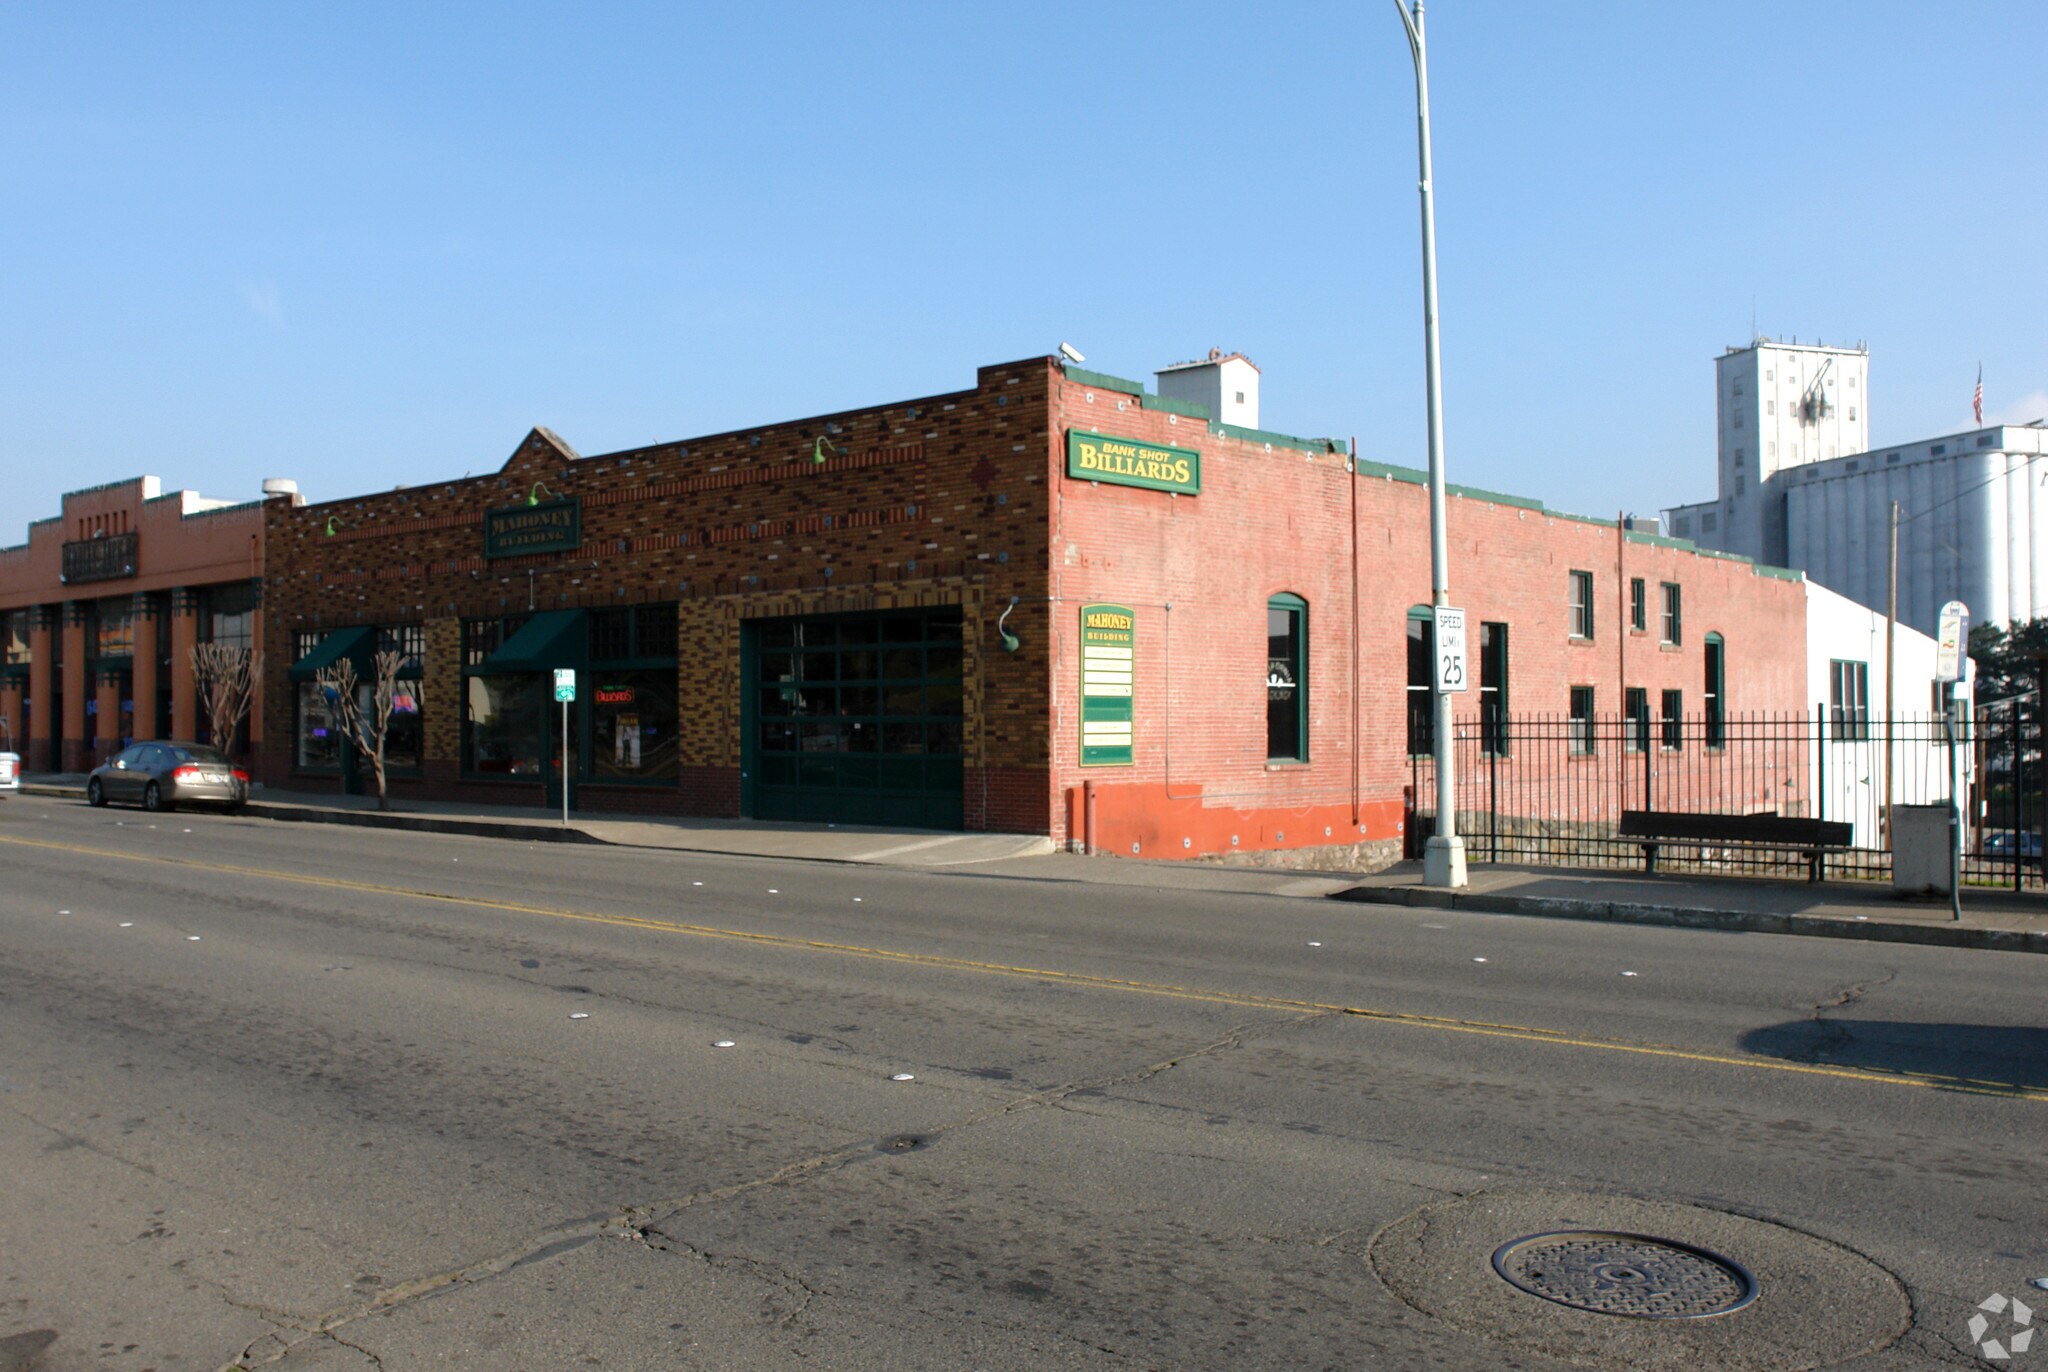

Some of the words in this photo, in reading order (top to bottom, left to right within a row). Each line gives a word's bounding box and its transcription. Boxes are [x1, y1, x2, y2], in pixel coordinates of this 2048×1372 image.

[1102, 442, 1136, 457] BANK
[1138, 448, 1171, 463] SHOT
[1079, 443, 1190, 483] BILLIARDS
[492, 510, 573, 536] MAHONEY
[499, 531, 565, 547] BUILDING
[1086, 613, 1132, 630] MAHONEY
[1440, 615, 1462, 629] SPEED
[1087, 632, 1130, 642] BUILDING
[1443, 655, 1462, 685] 25
